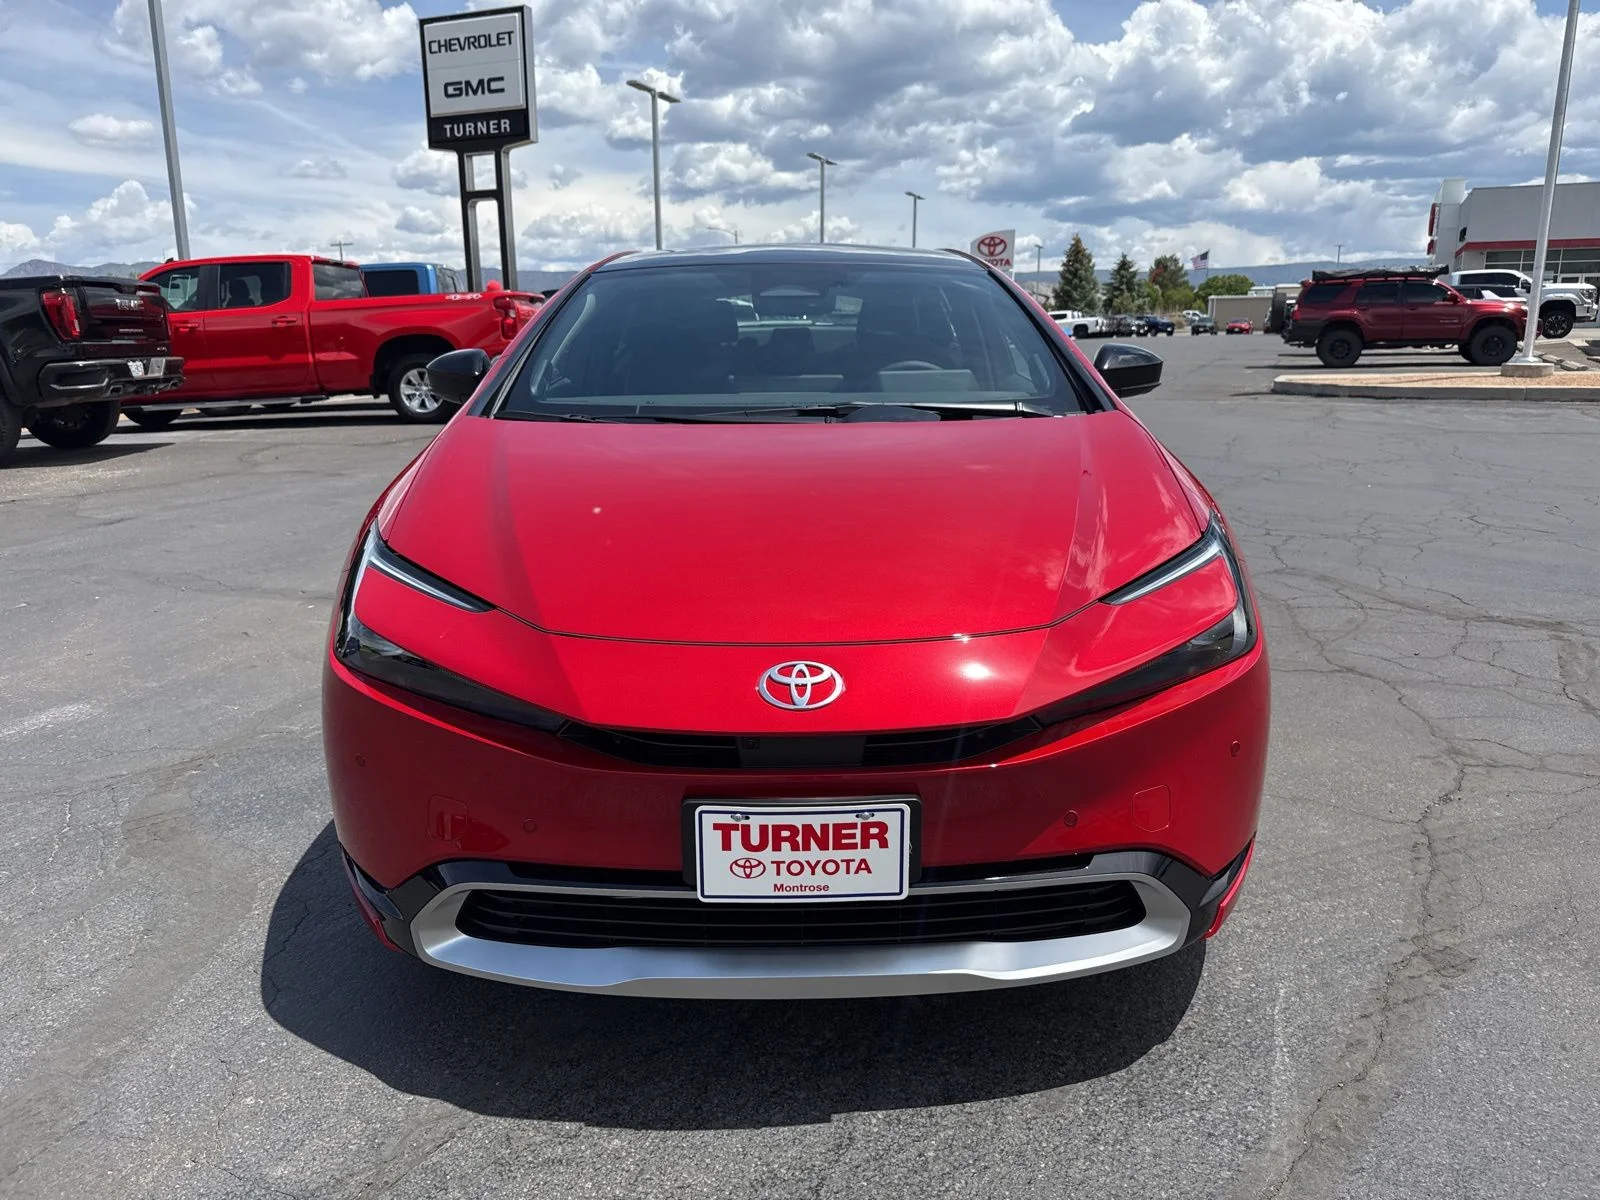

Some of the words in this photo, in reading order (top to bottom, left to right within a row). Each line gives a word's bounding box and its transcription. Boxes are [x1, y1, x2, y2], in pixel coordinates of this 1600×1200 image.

[428, 31, 514, 54] CHEVROLET
[443, 76, 505, 98] GMC
[444, 119, 511, 137] TURNER
[712, 821, 889, 853] TURNER
[771, 858, 873, 877] TOYOTA
[773, 883, 830, 893] Montrose
